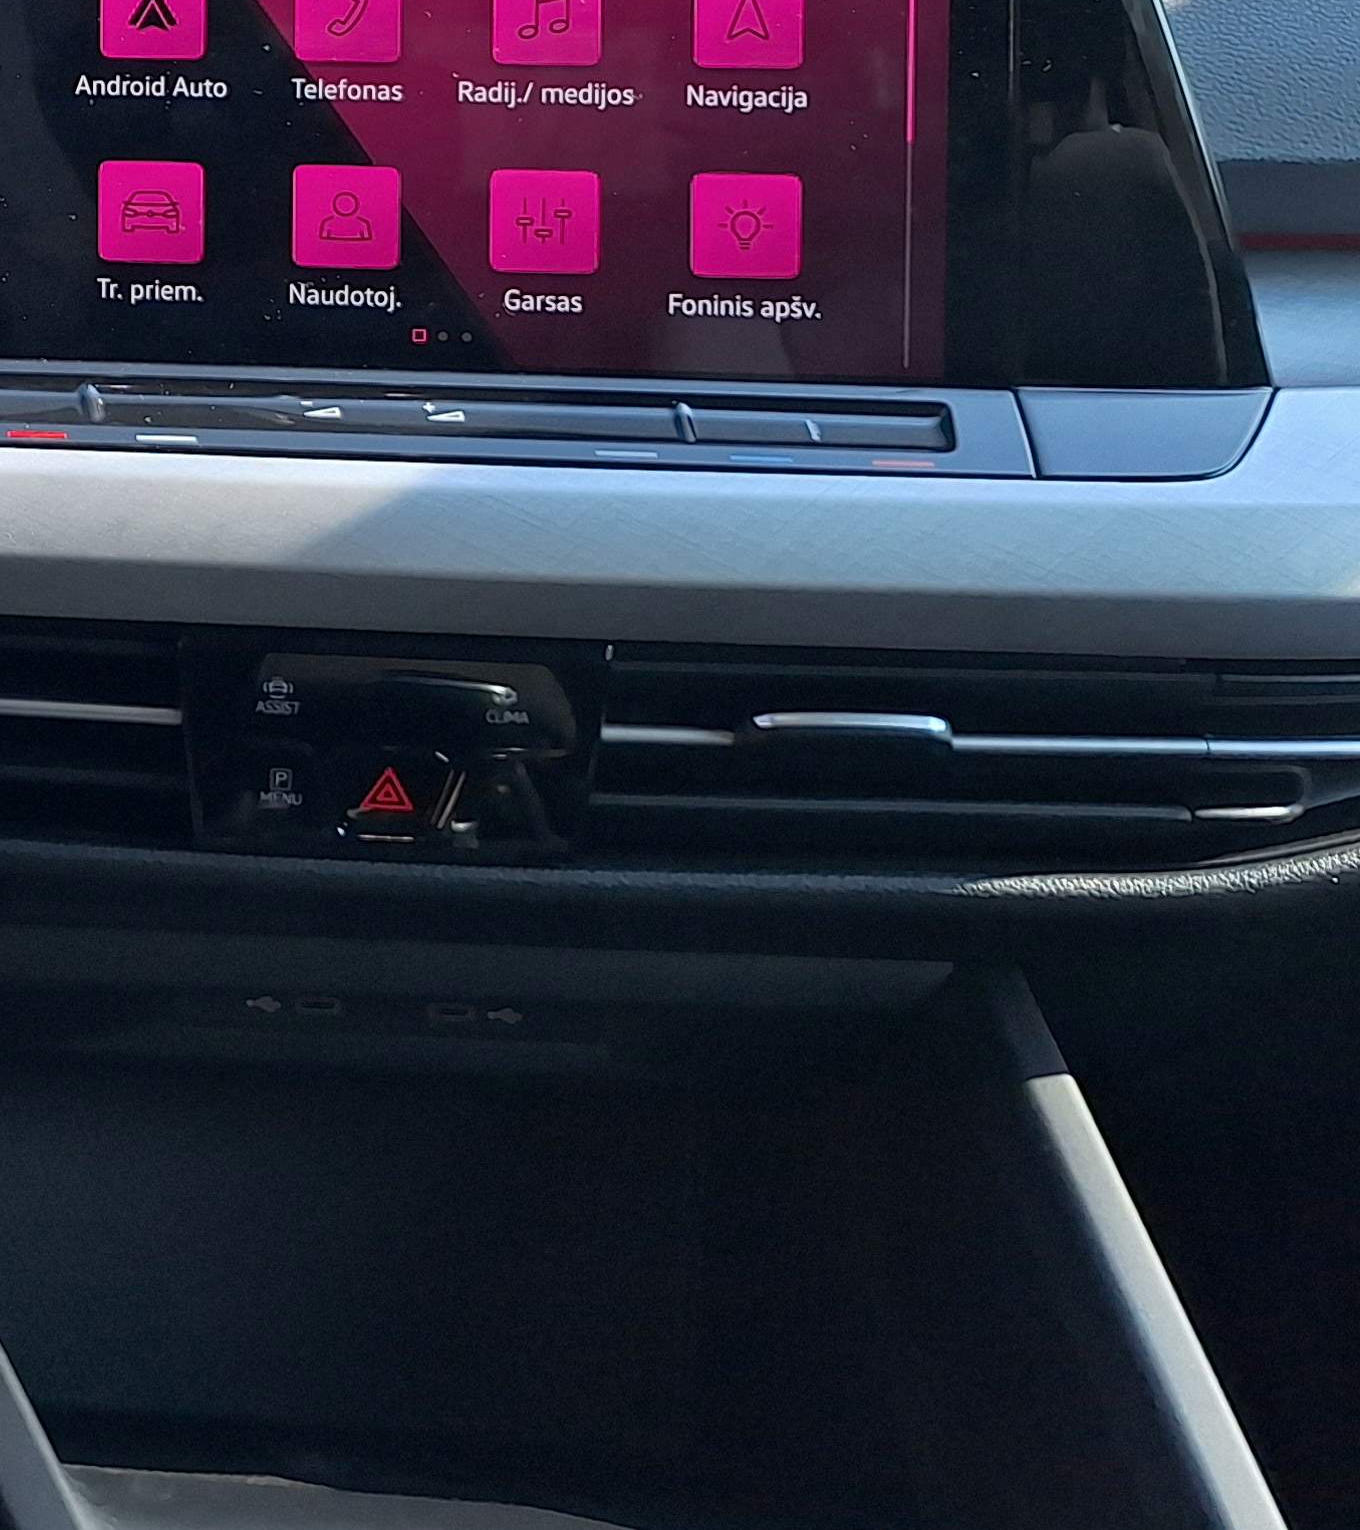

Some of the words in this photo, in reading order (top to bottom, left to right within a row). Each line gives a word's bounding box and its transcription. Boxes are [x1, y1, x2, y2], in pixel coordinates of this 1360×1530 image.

[75, 76, 166, 98] Android
[172, 77, 228, 99] Auto
[291, 78, 403, 102] Telefonas
[541, 83, 634, 108] medijos
[686, 85, 808, 113] Navigacija
[97, 279, 125, 301] Tr.
[130, 280, 203, 305] priem.
[288, 285, 402, 310] Naudotoj.
[504, 291, 583, 314] Garsas
[668, 294, 754, 318] Foninis
[760, 295, 821, 321] apšv.
[256, 700, 301, 716] ASSIST
[260, 791, 302, 807] MENU
